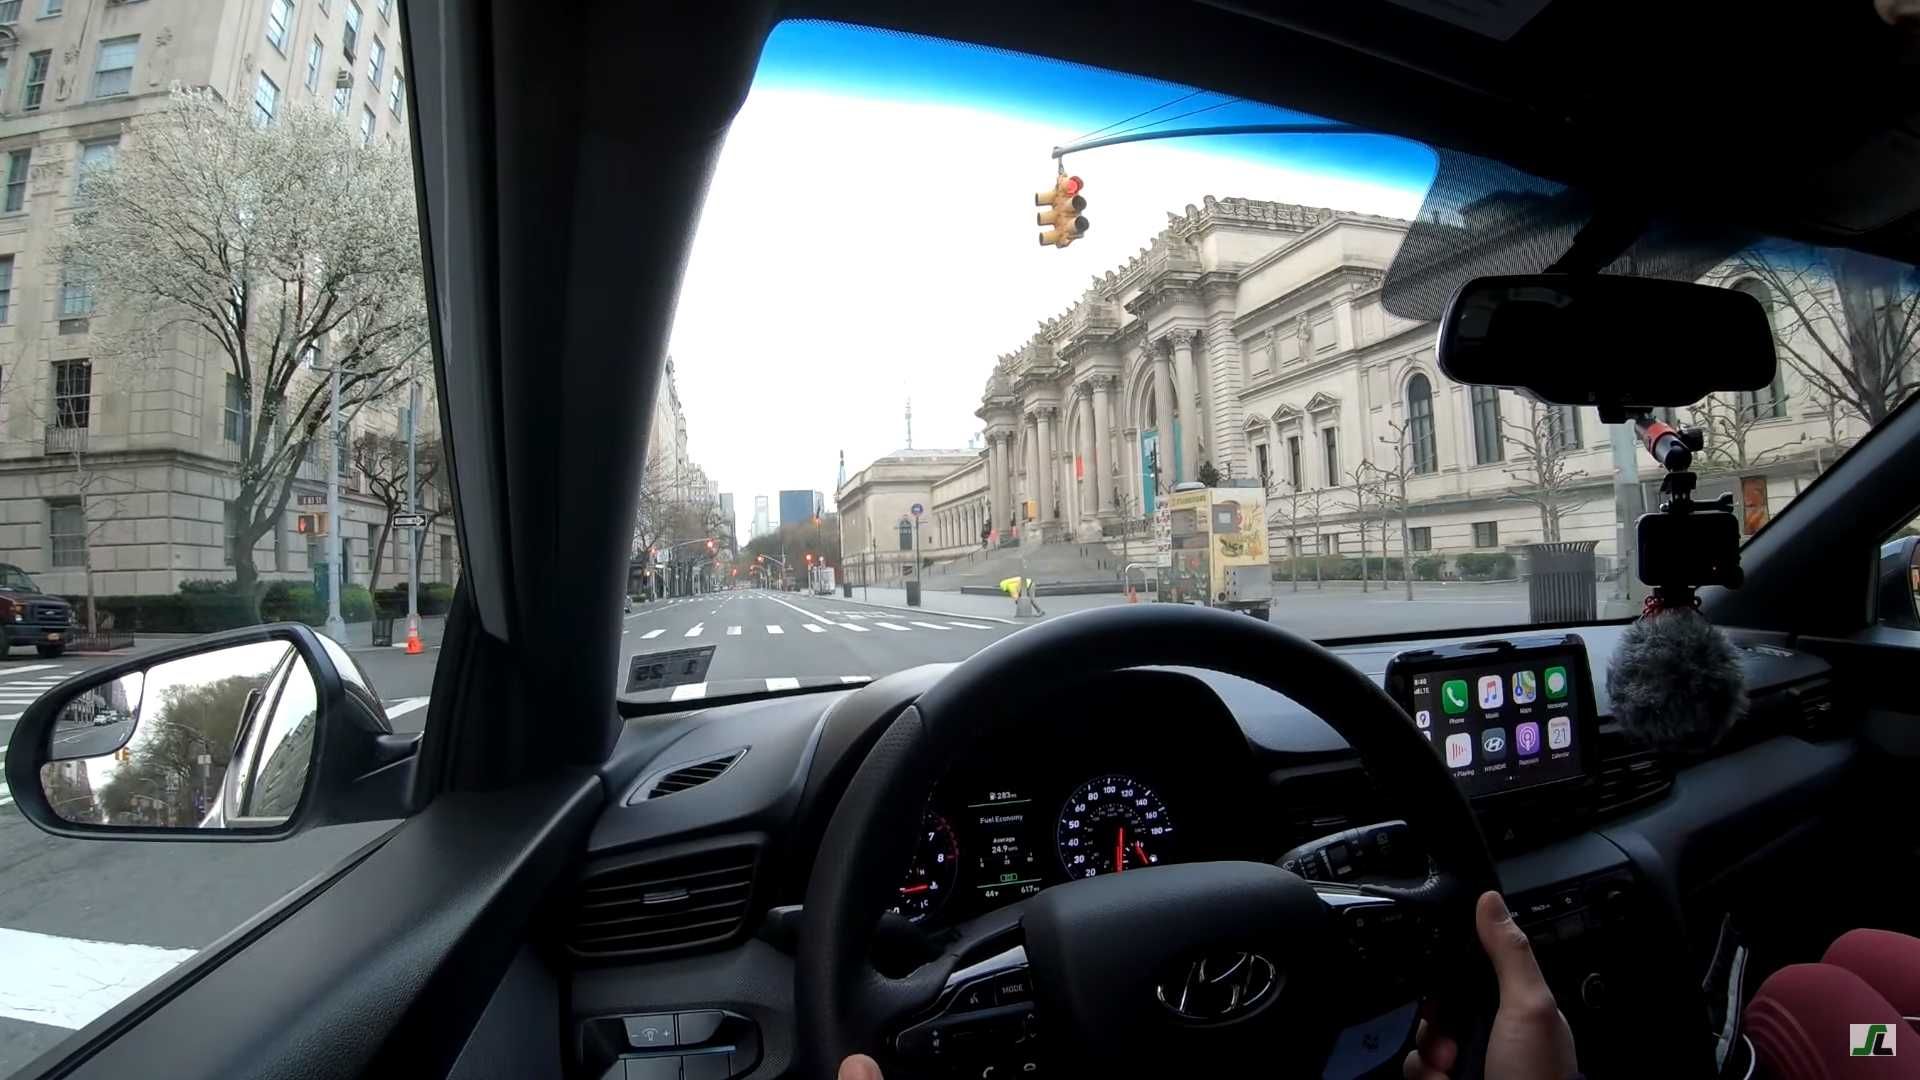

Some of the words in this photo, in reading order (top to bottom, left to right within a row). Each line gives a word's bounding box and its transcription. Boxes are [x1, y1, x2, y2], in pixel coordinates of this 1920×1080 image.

[1553, 728, 1567, 745] 21
[1103, 785, 1116, 794] 100
[1121, 789, 1134, 797] 120
[1087, 792, 1099, 801] 80
[1135, 798, 1148, 806] 140
[1074, 803, 1086, 813] 60
[1145, 810, 1158, 819] 160
[979, 816, 994, 824] Fuel
[995, 815, 1024, 823] Economy
[1068, 820, 1080, 829] 50
[1150, 826, 1164, 835] 180
[928, 831, 936, 841] 7
[993, 836, 1016, 844] Average
[1068, 838, 1079, 847] 40
[937, 853, 945, 863] 8
[1073, 854, 1085, 864] 30
[1084, 868, 1096, 877] 20
[1001, 983, 1024, 994] MODE
